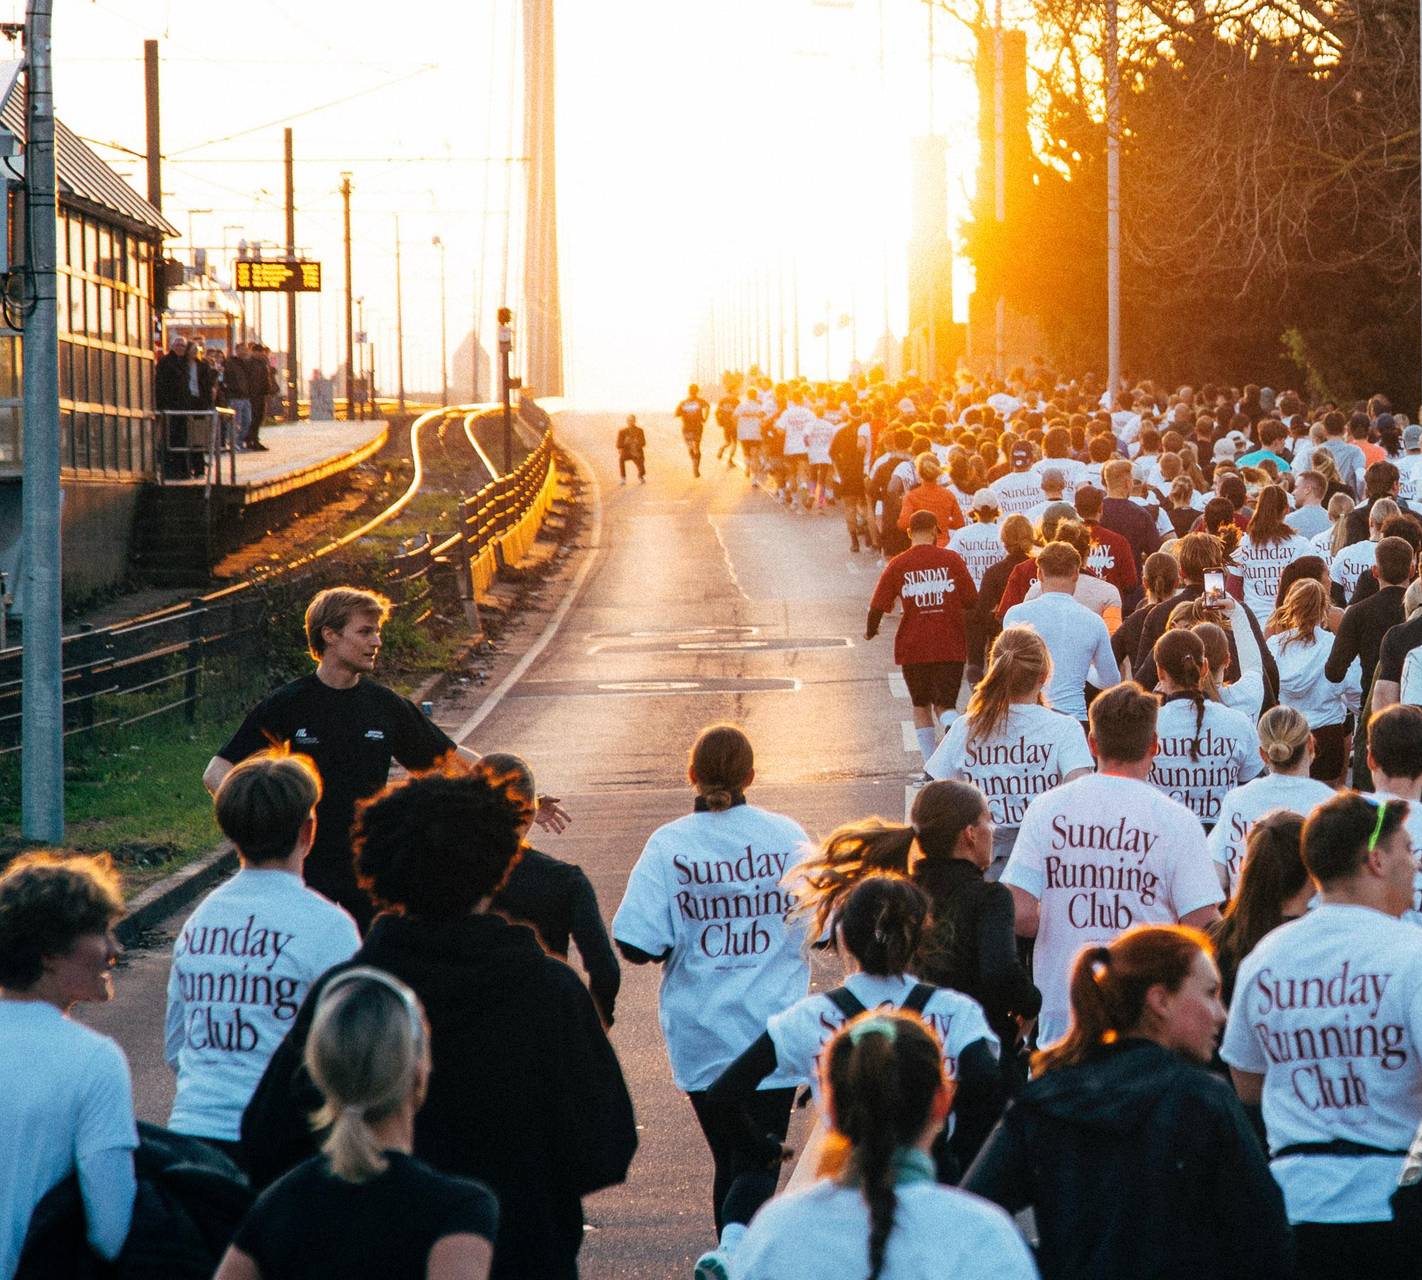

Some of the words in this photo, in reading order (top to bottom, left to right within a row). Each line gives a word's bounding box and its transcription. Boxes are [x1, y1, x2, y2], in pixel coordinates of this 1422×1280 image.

[1001, 484, 1041, 499] Sunday
[959, 537, 1000, 552] Sunday
[1242, 543, 1296, 563] Sunday
[904, 567, 949, 586] SUNDAY
[915, 592, 945, 607] CLUB
[964, 735, 1055, 771] Sunday
[1051, 814, 1159, 865] Sunday
[673, 844, 789, 887] Sunday
[1045, 855, 1160, 907] Running
[1068, 891, 1133, 930] Club
[701, 920, 771, 959] Club
[176, 964, 300, 1020] unning
[1256, 960, 1393, 1020] Sunday
[189, 1006, 259, 1051] Club
[1254, 1013, 1408, 1071] Running
[1292, 1062, 1369, 1112] Club
